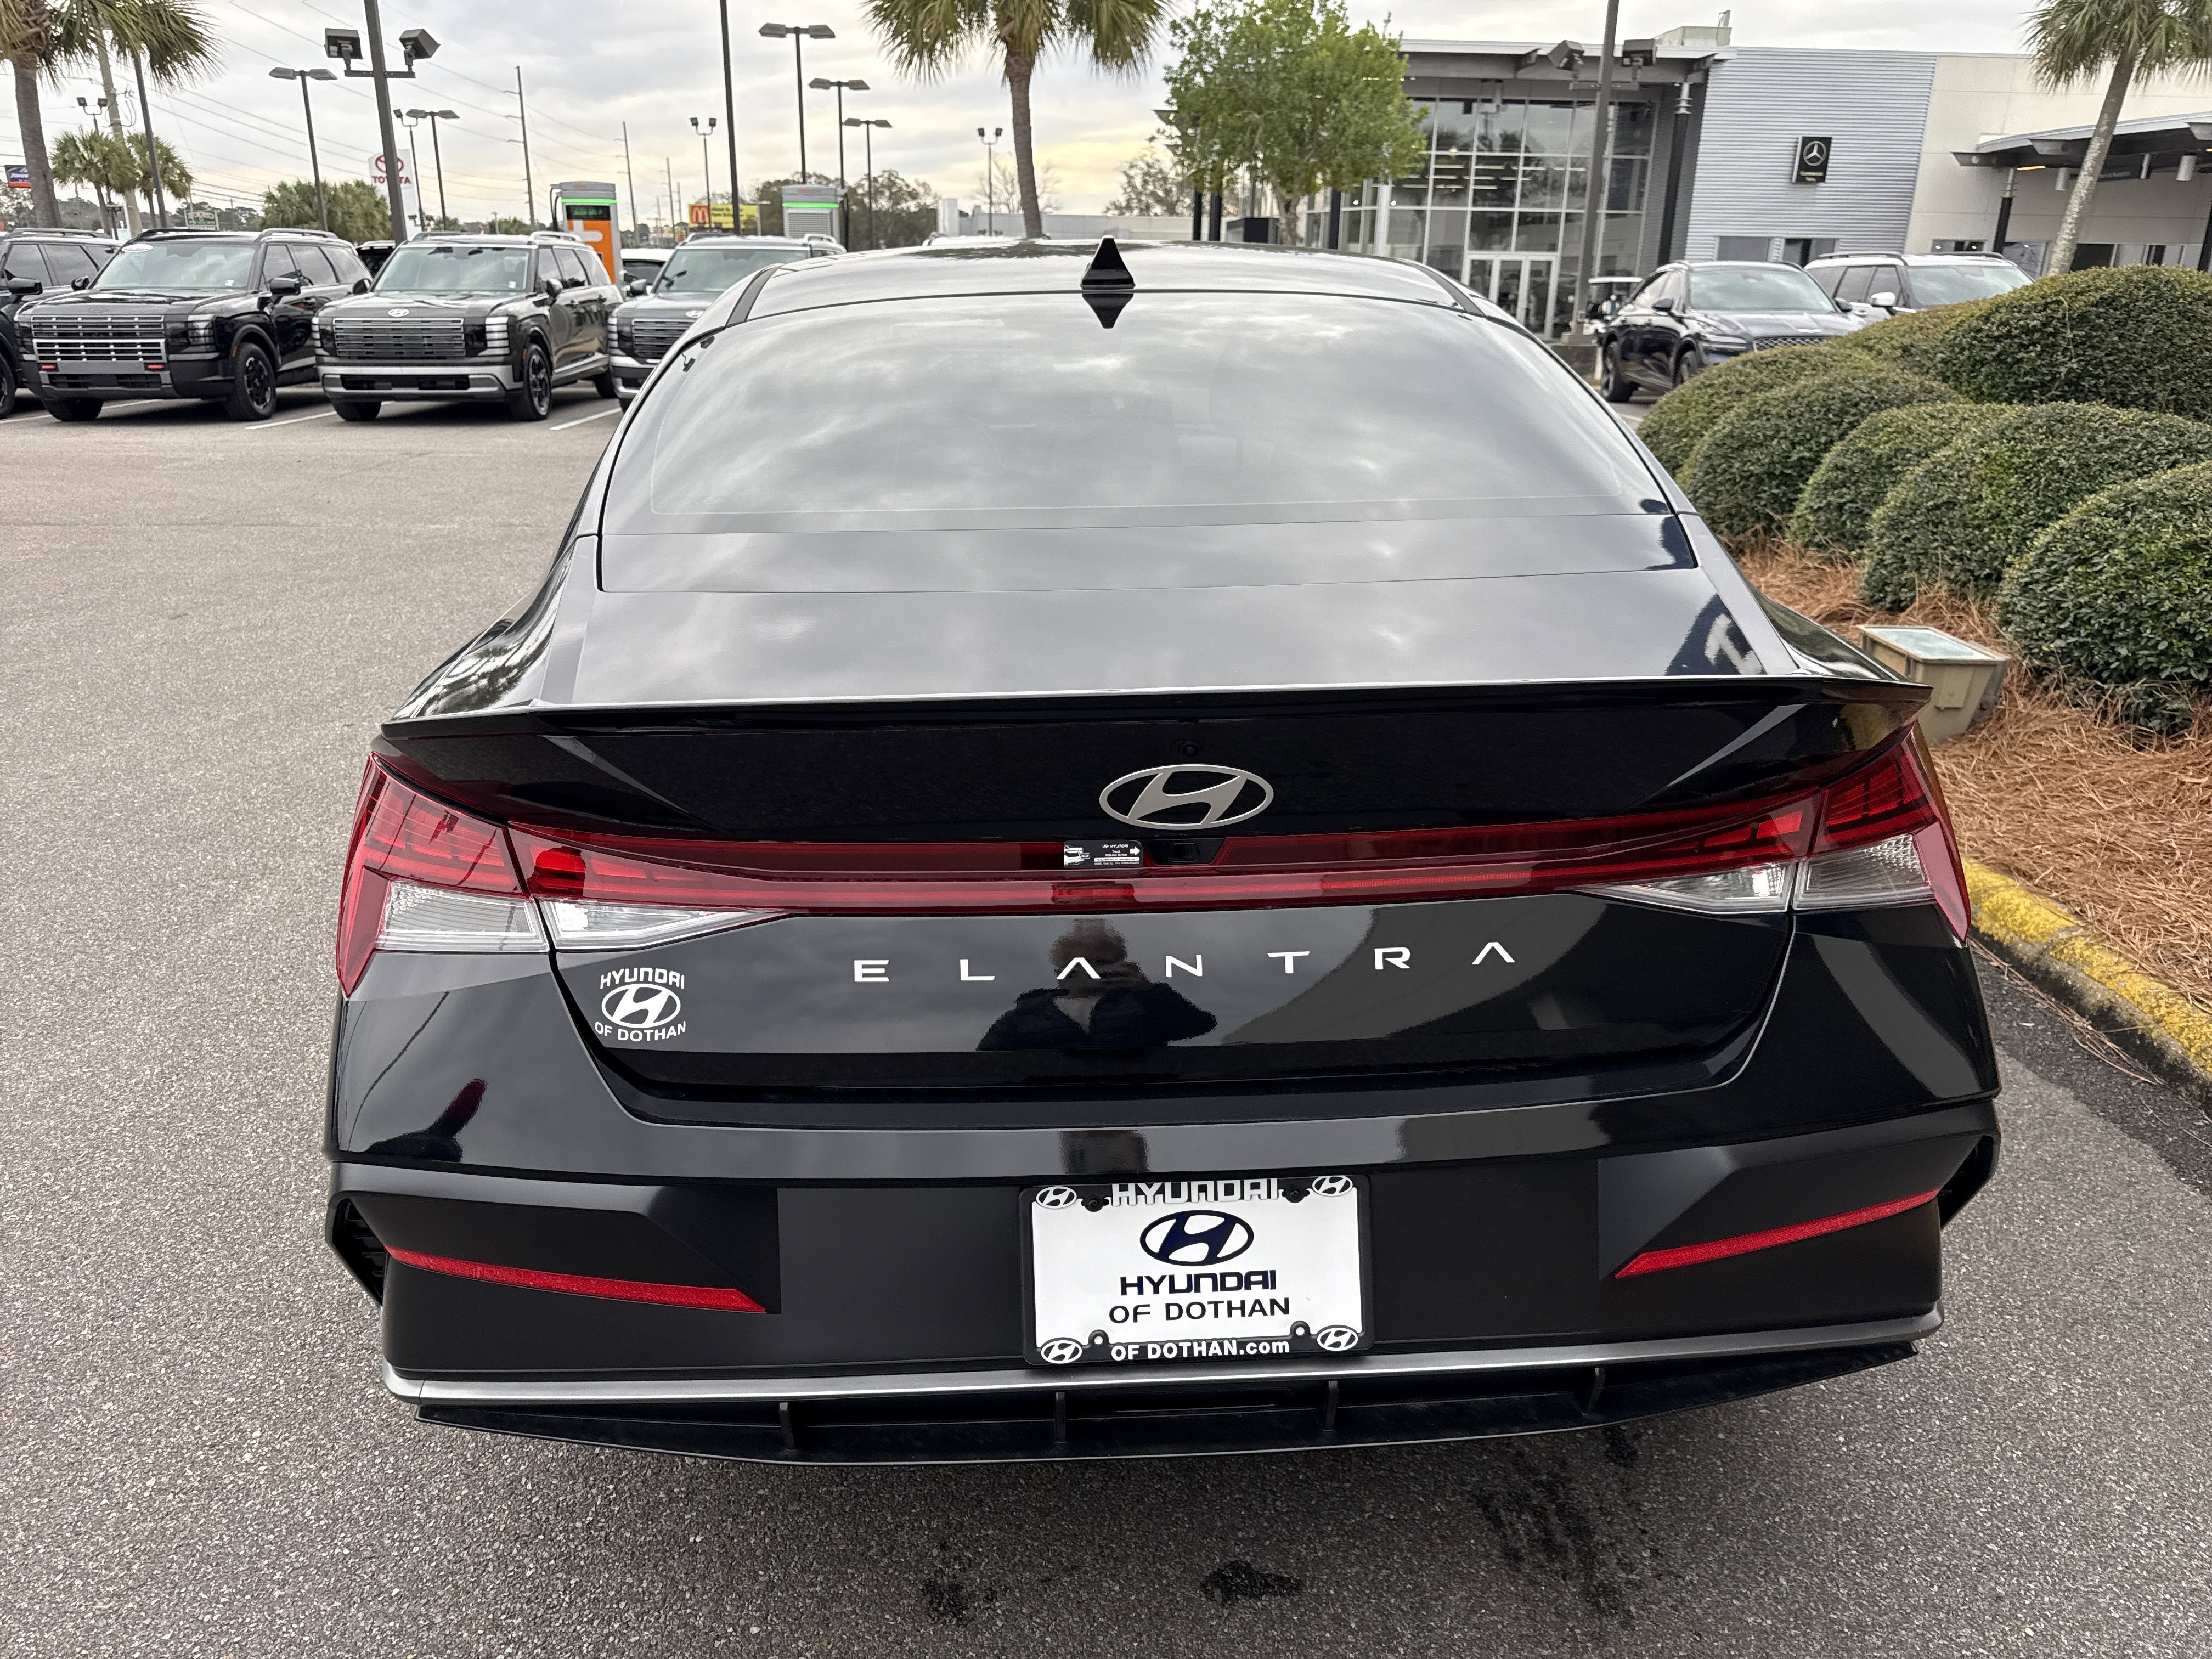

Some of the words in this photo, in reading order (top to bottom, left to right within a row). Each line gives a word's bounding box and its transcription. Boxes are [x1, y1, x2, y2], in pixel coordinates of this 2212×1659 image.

[371, 176, 412, 184] TOTA
[854, 942, 1515, 982] ELANTRA
[600, 967, 685, 990] HYUNDAI
[595, 1022, 613, 1036] OF
[617, 1020, 686, 1042] DOTHAN
[1111, 1178, 1278, 1207] HYUNDAI
[1120, 1269, 1277, 1296] HYUNDAI
[1109, 1304, 1150, 1324] OF
[1165, 1297, 1290, 1321] DOTHAN
[1111, 1344, 1139, 1361] OF
[1147, 1340, 1289, 1359] DOTHAN.com
